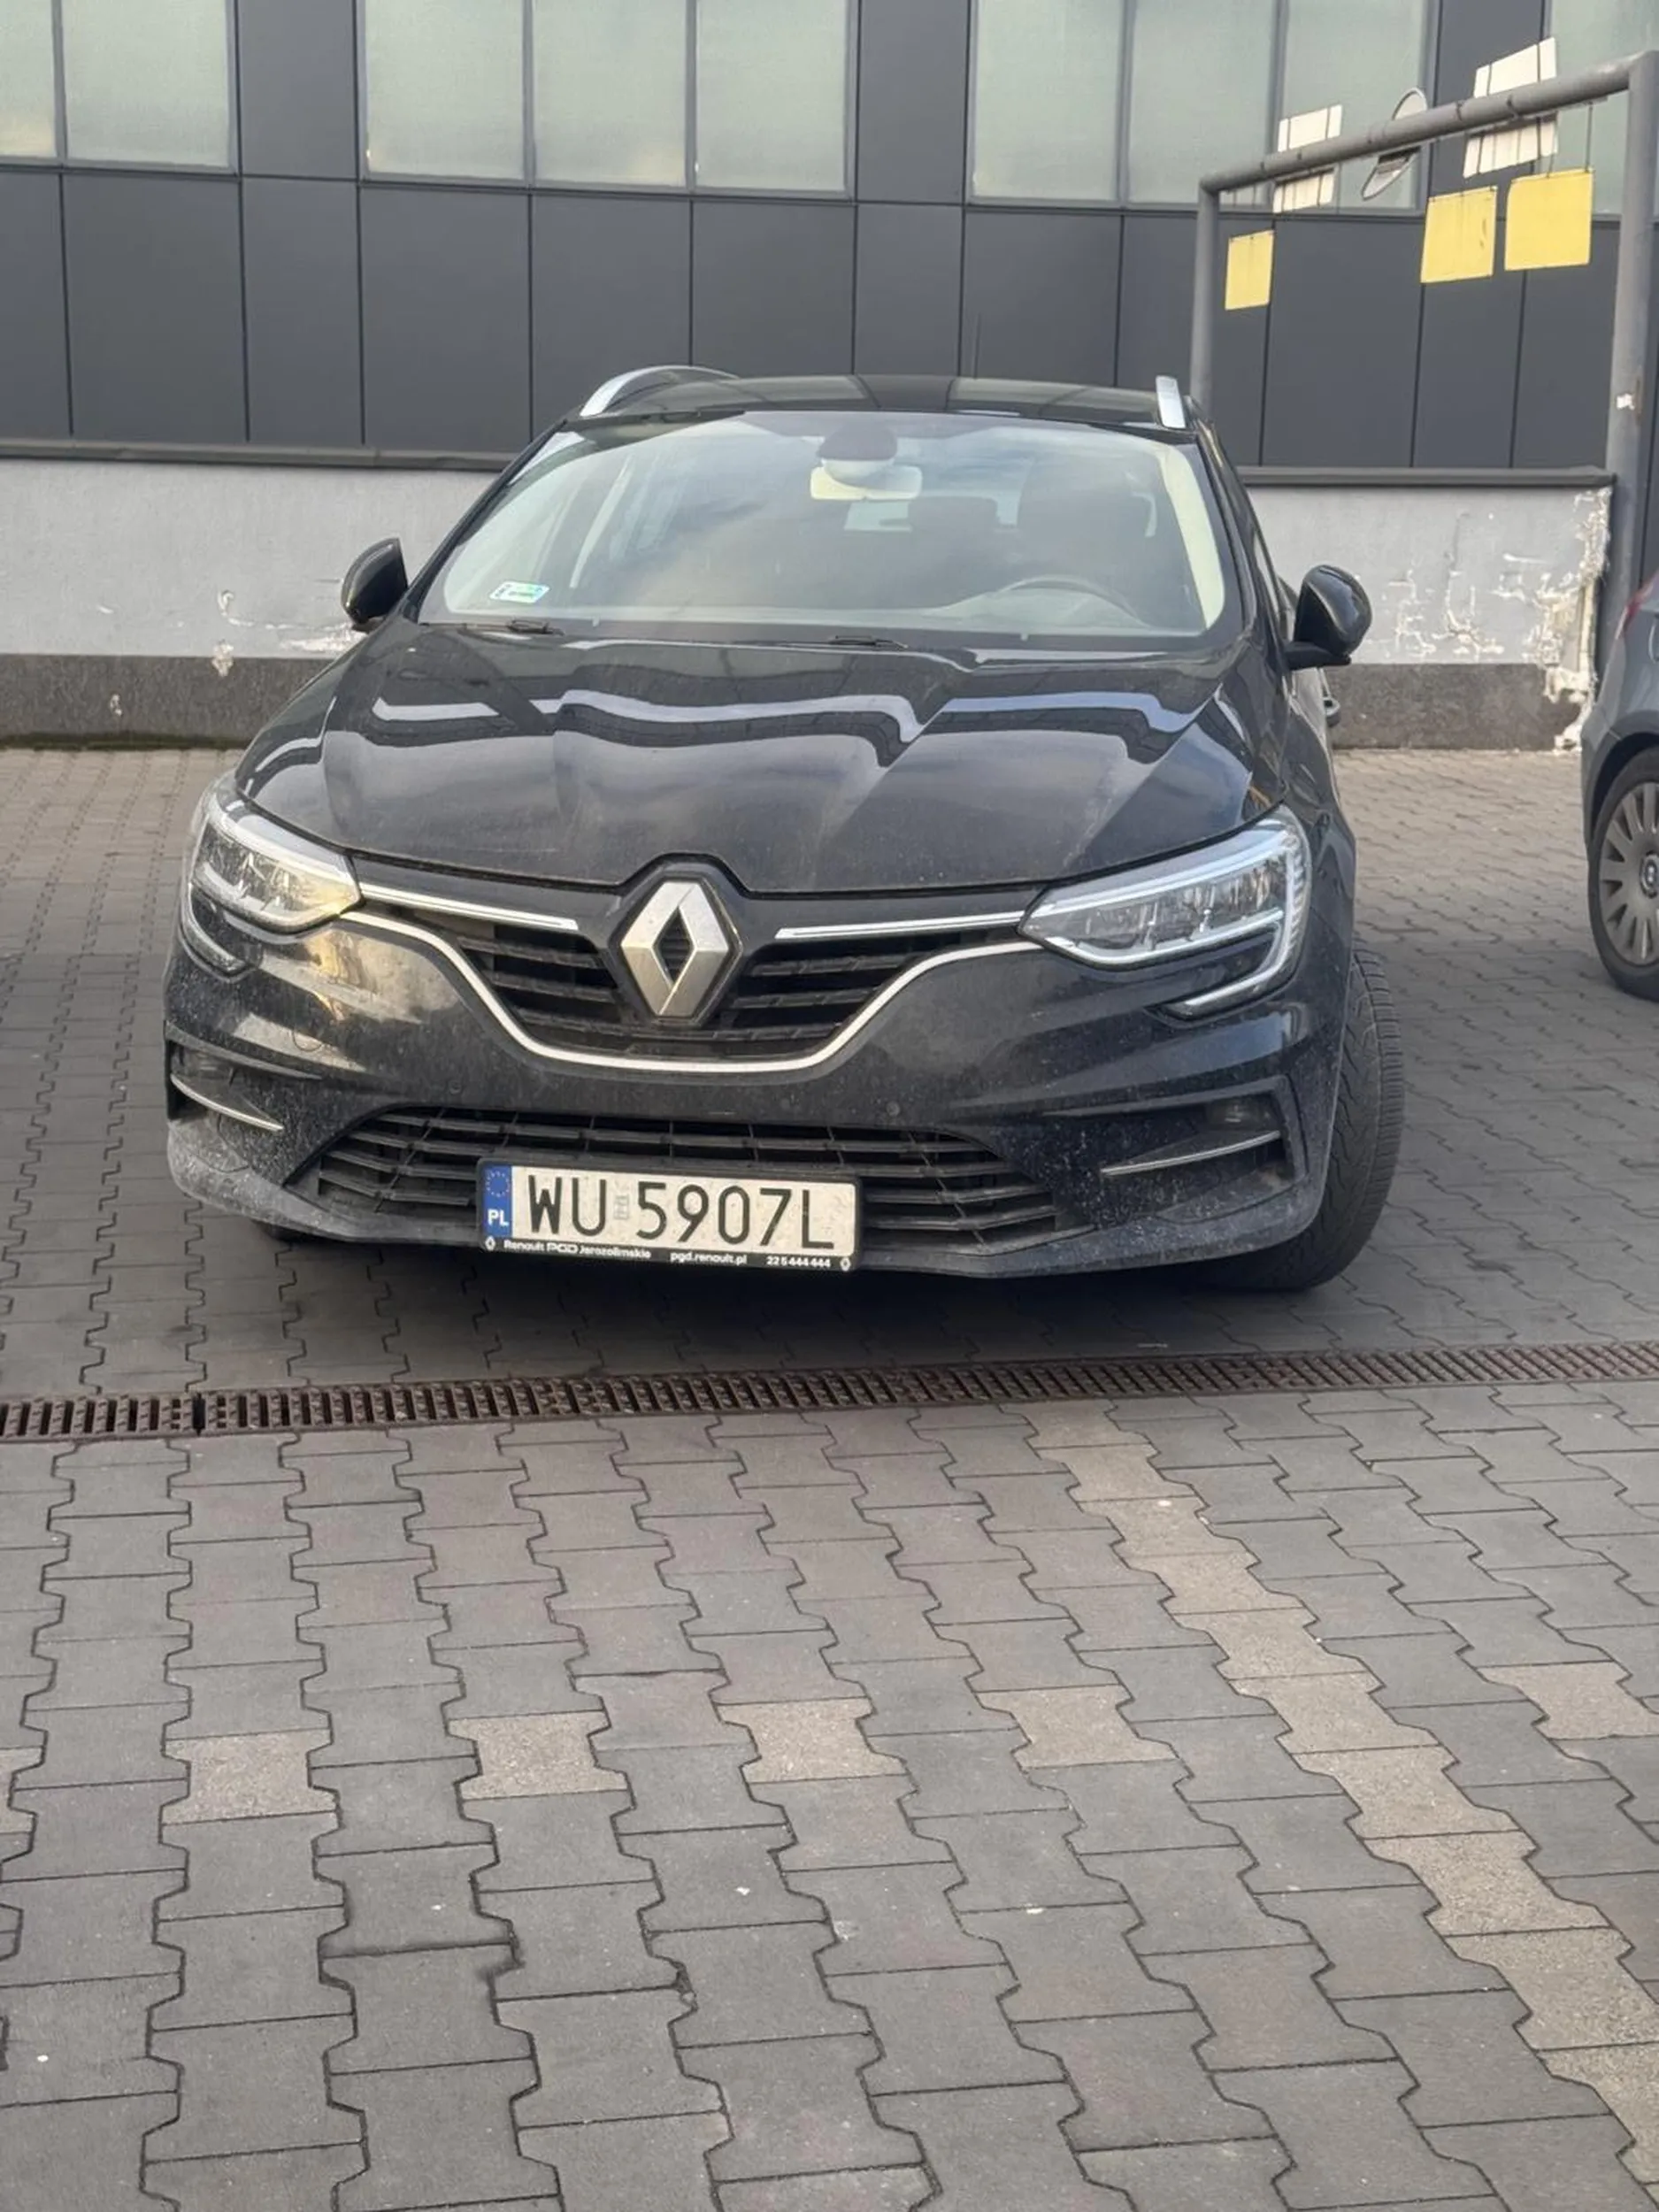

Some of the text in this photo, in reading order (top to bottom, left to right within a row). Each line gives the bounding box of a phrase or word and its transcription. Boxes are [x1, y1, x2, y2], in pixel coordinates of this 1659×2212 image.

[488, 1209, 509, 1226] PL
[528, 1174, 834, 1249] WU 5907L
